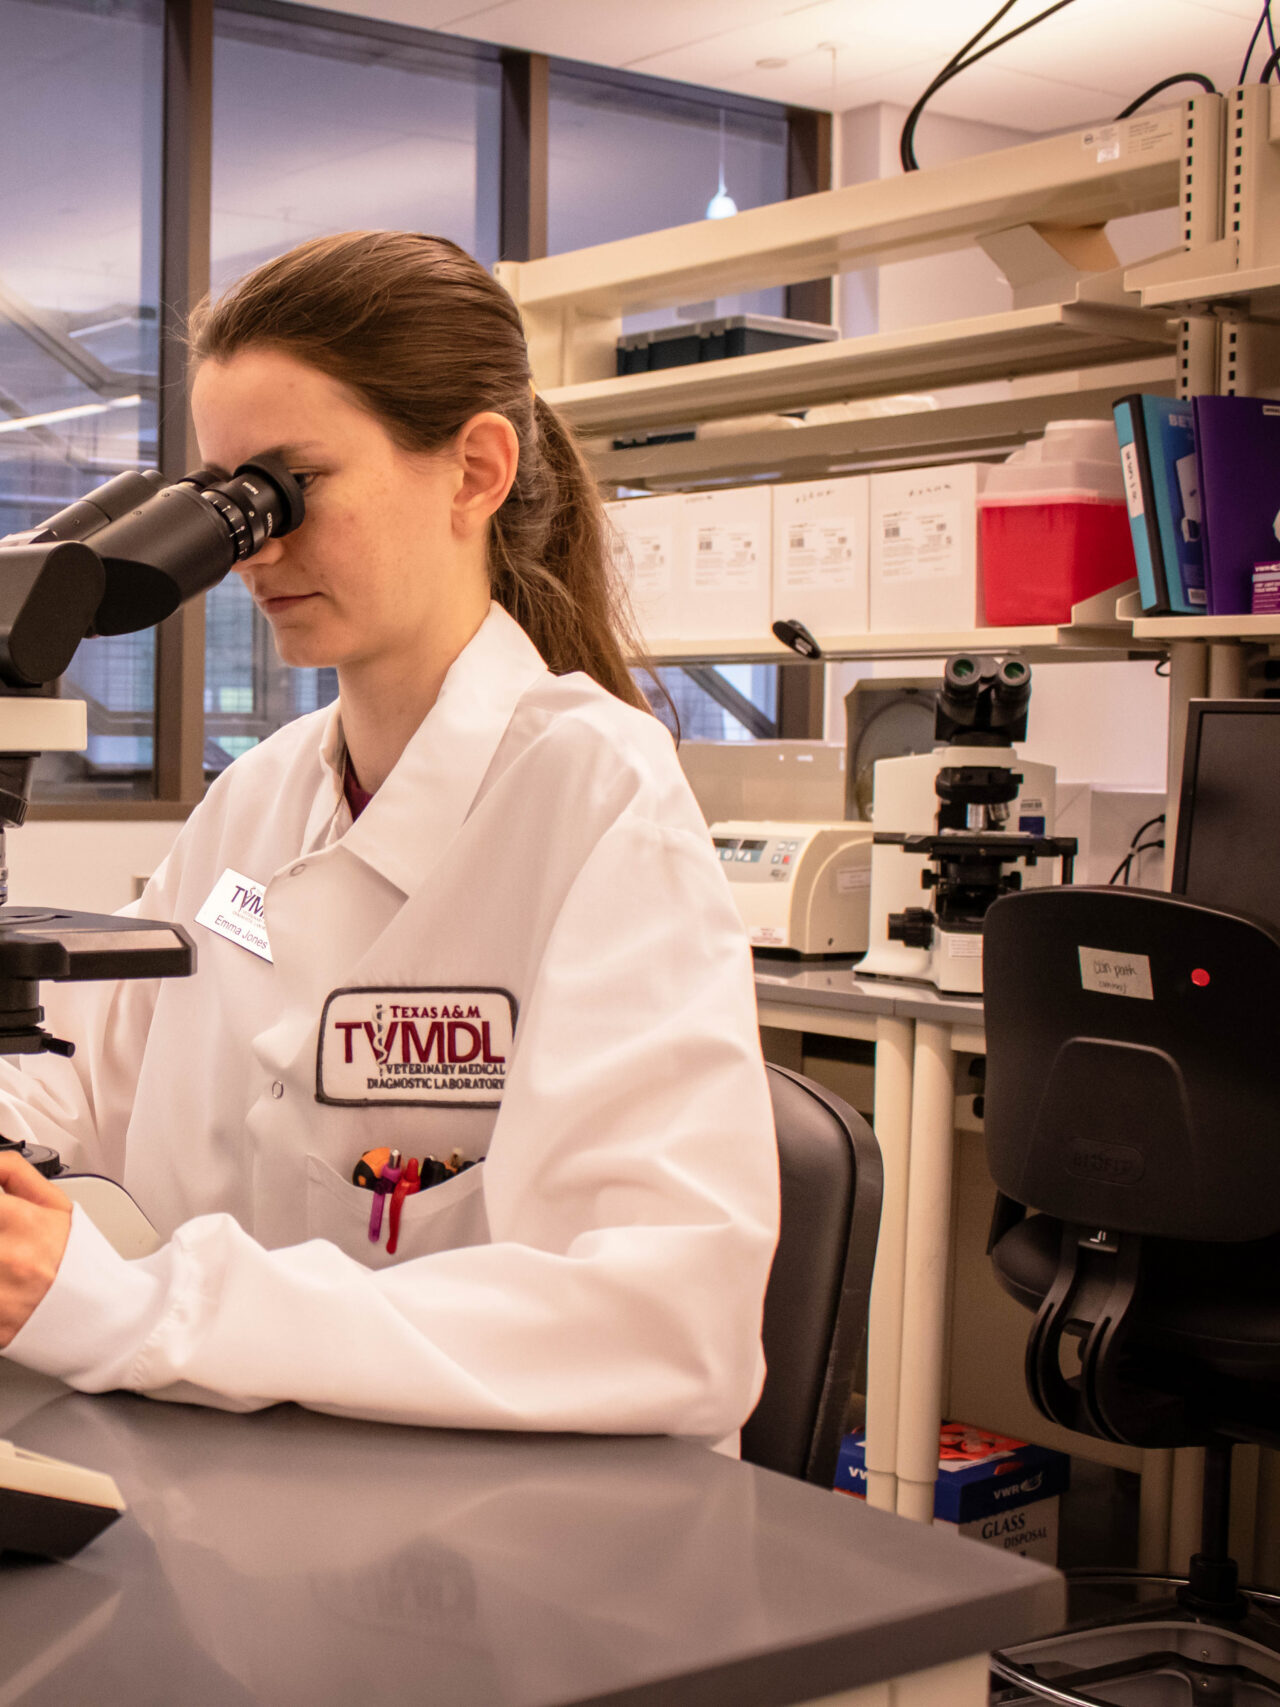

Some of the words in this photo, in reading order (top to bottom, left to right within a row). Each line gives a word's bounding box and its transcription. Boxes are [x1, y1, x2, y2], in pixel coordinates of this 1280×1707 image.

[230, 885, 265, 918] TVM
[214, 914, 242, 936] Emma
[242, 929, 269, 949] Jones
[389, 1005, 438, 1019] TEXAS
[441, 1004, 481, 1019] A&M
[335, 1020, 506, 1064] TVMDL
[386, 1064, 456, 1075] VETERINARY
[458, 1064, 506, 1075] MEDICAL
[367, 1077, 432, 1090] DIAGNOSTIC
[434, 1077, 506, 1090] LABORATORY
[993, 1484, 1020, 1500] VWR
[981, 1512, 1026, 1540] GLASS
[1003, 1526, 1048, 1549] DISPOSAL
